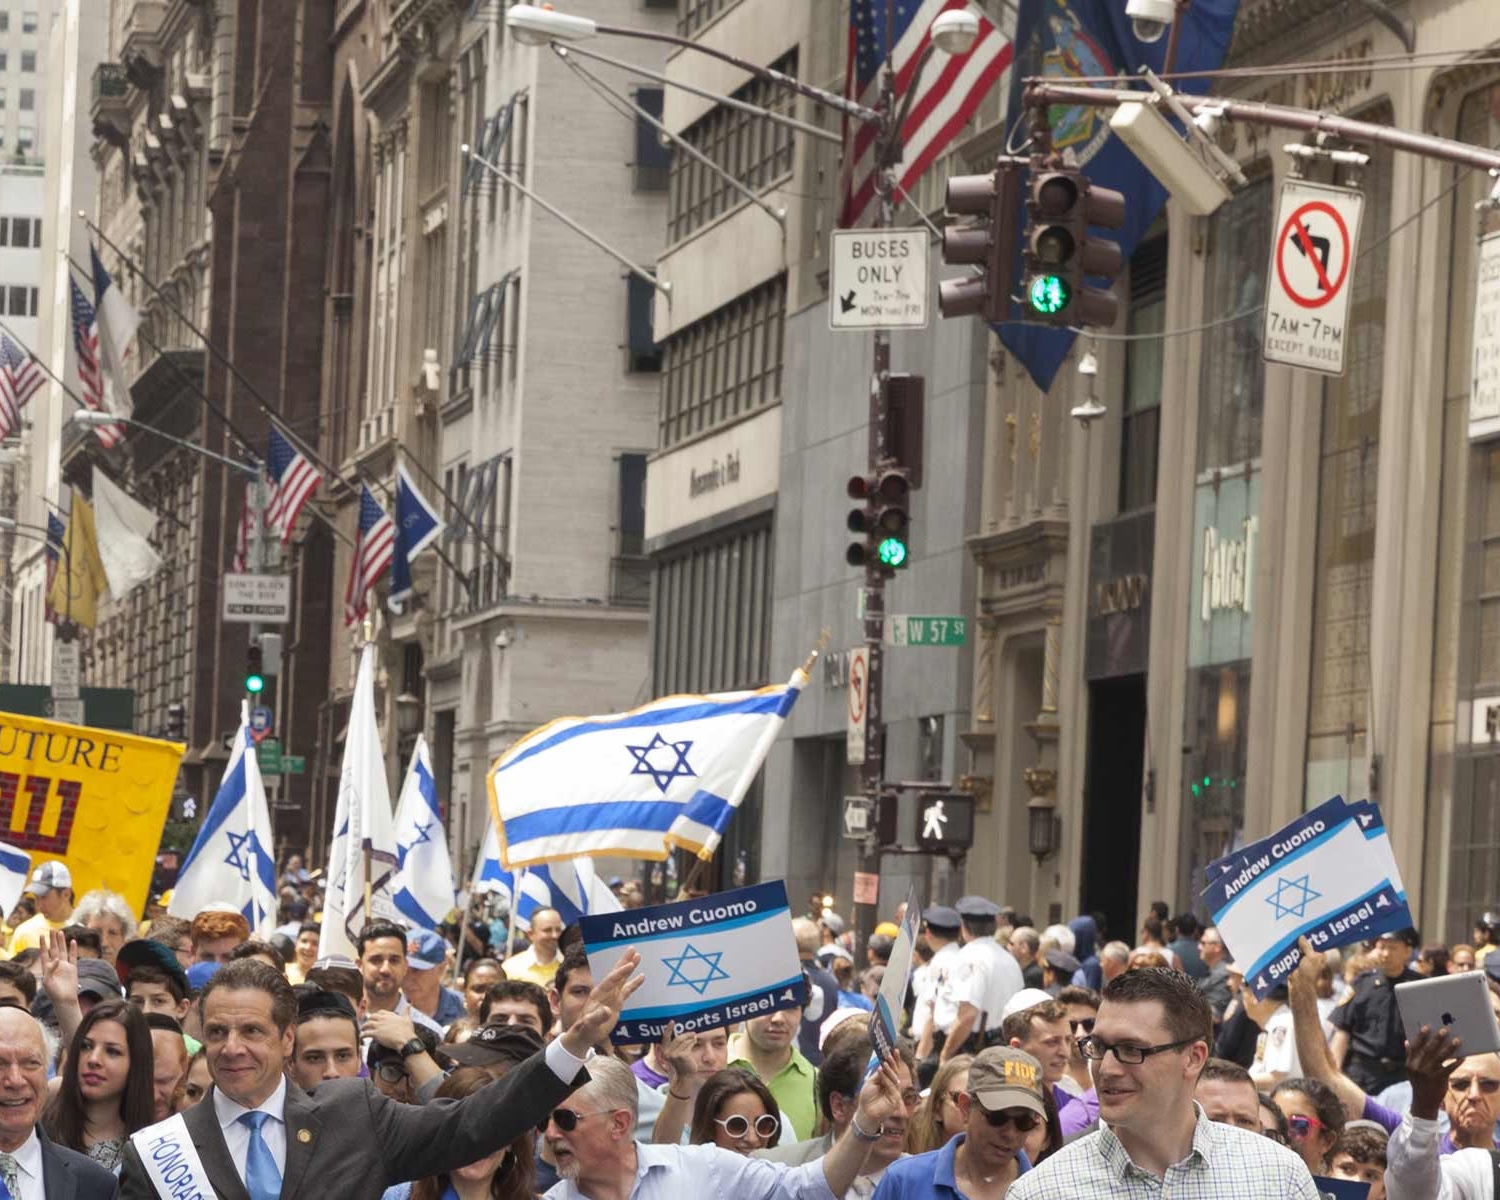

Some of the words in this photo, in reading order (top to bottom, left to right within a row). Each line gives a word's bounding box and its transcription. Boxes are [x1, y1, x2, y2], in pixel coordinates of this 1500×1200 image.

[852, 241, 909, 259] BUSES
[858, 265, 902, 283] ONLY
[1268, 338, 1303, 354] EXCEPT
[1308, 345, 1340, 361] BUSES
[908, 620, 924, 643] W
[930, 620, 948, 643] 57
[1224, 854, 1270, 899] Andrew
[1272, 820, 1325, 858] Cuomo
[612, 914, 684, 938] Andrew
[689, 900, 757, 926] Cuomo
[1269, 930, 1328, 979] Supprts
[1329, 902, 1374, 936] Israel
[726, 995, 775, 1020] Israel
